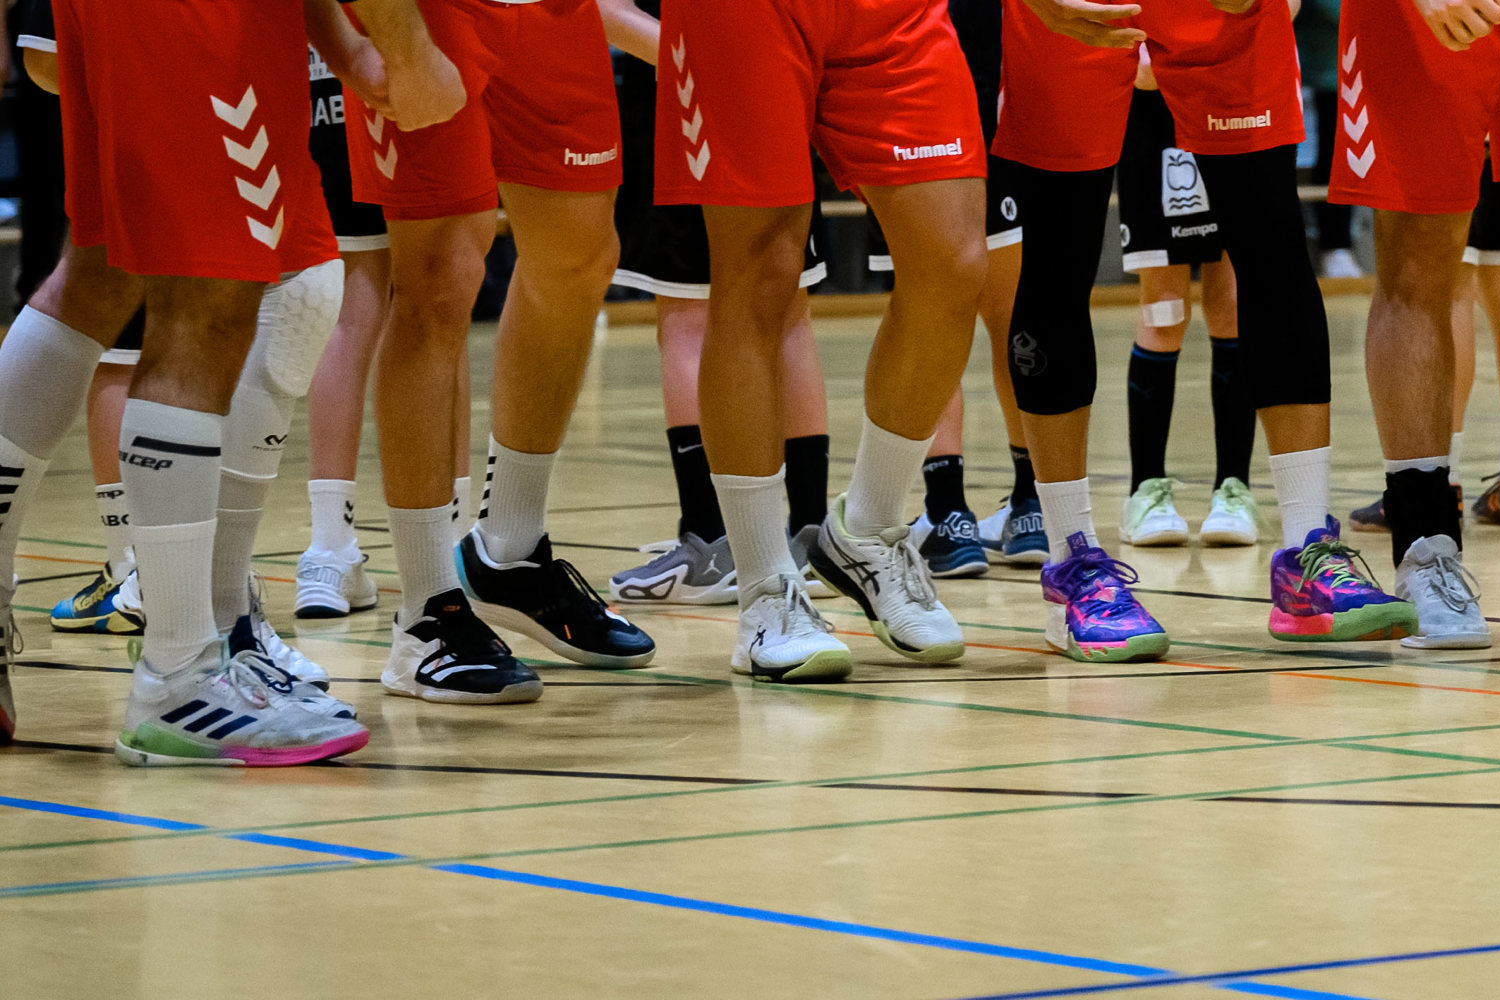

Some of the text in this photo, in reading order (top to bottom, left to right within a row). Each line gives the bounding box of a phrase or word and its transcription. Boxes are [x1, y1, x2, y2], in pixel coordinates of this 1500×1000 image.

[1207, 110, 1271, 131] hummel
[893, 138, 962, 161] hummel
[1171, 223, 1218, 238] Kempa
